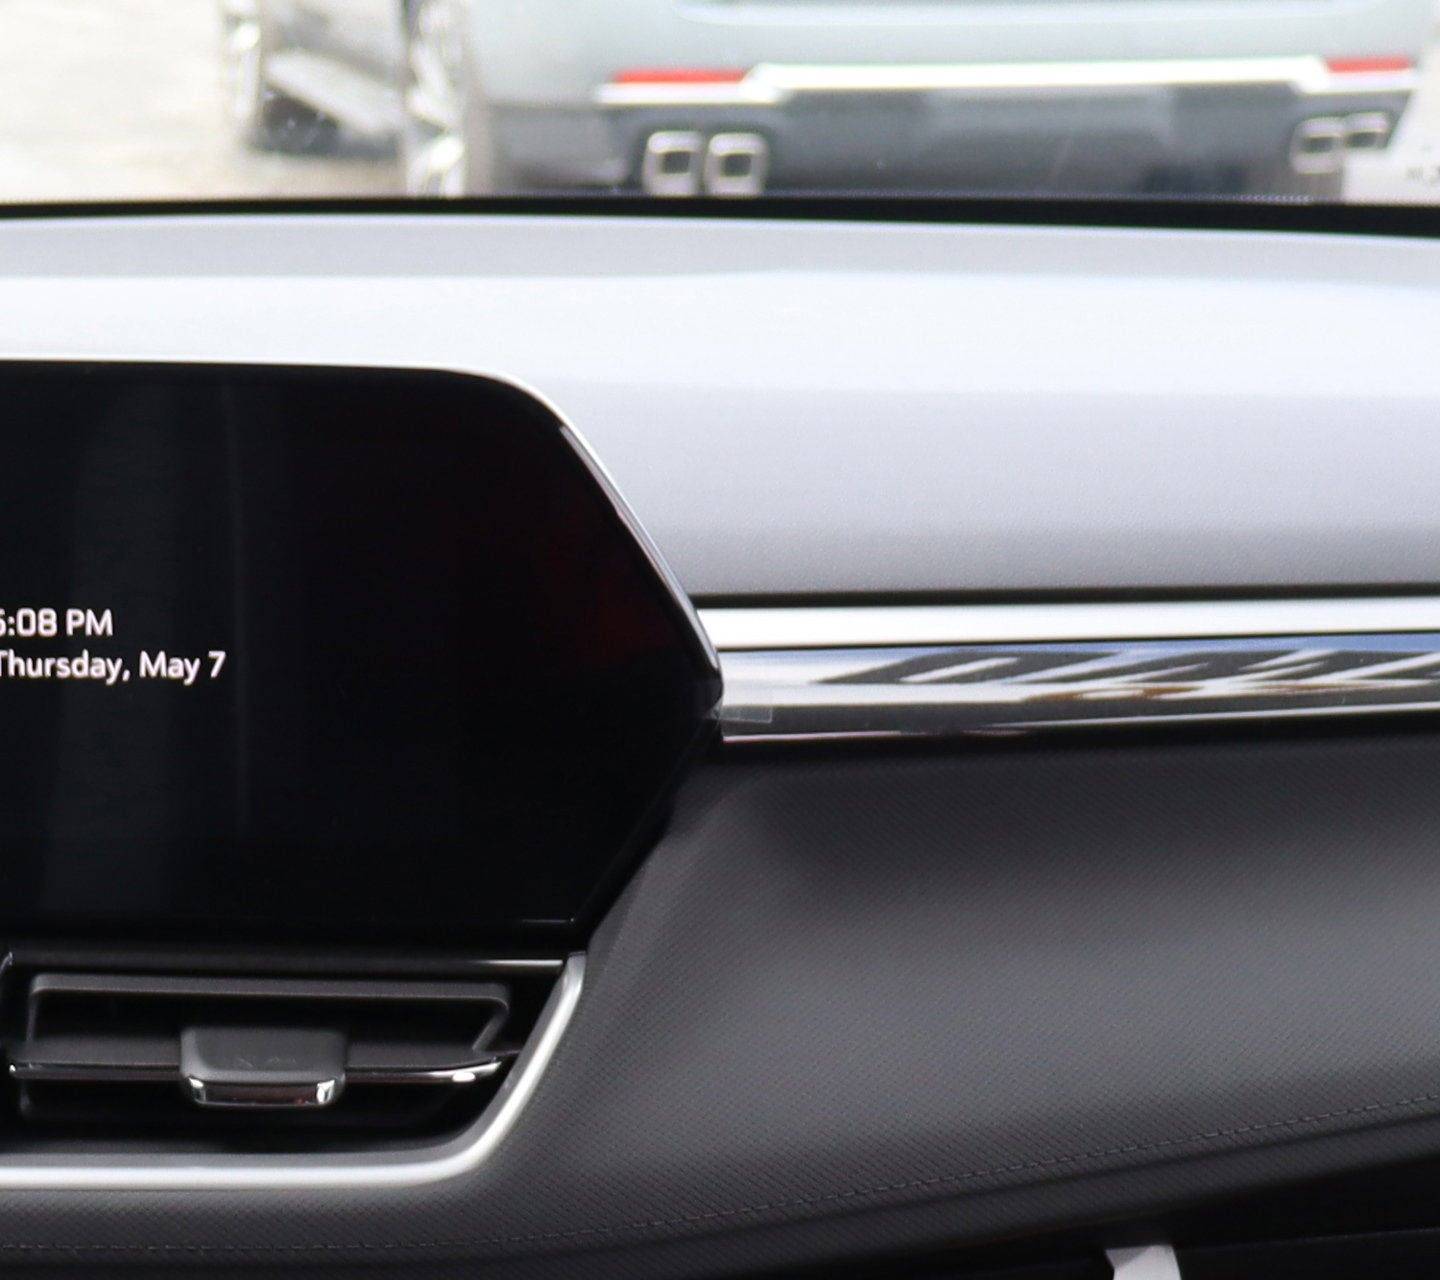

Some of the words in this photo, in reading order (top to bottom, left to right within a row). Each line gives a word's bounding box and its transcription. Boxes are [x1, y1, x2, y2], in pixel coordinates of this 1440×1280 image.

[65, 607, 113, 637] PM
[138, 650, 201, 686] May
[207, 650, 226, 679] 7
